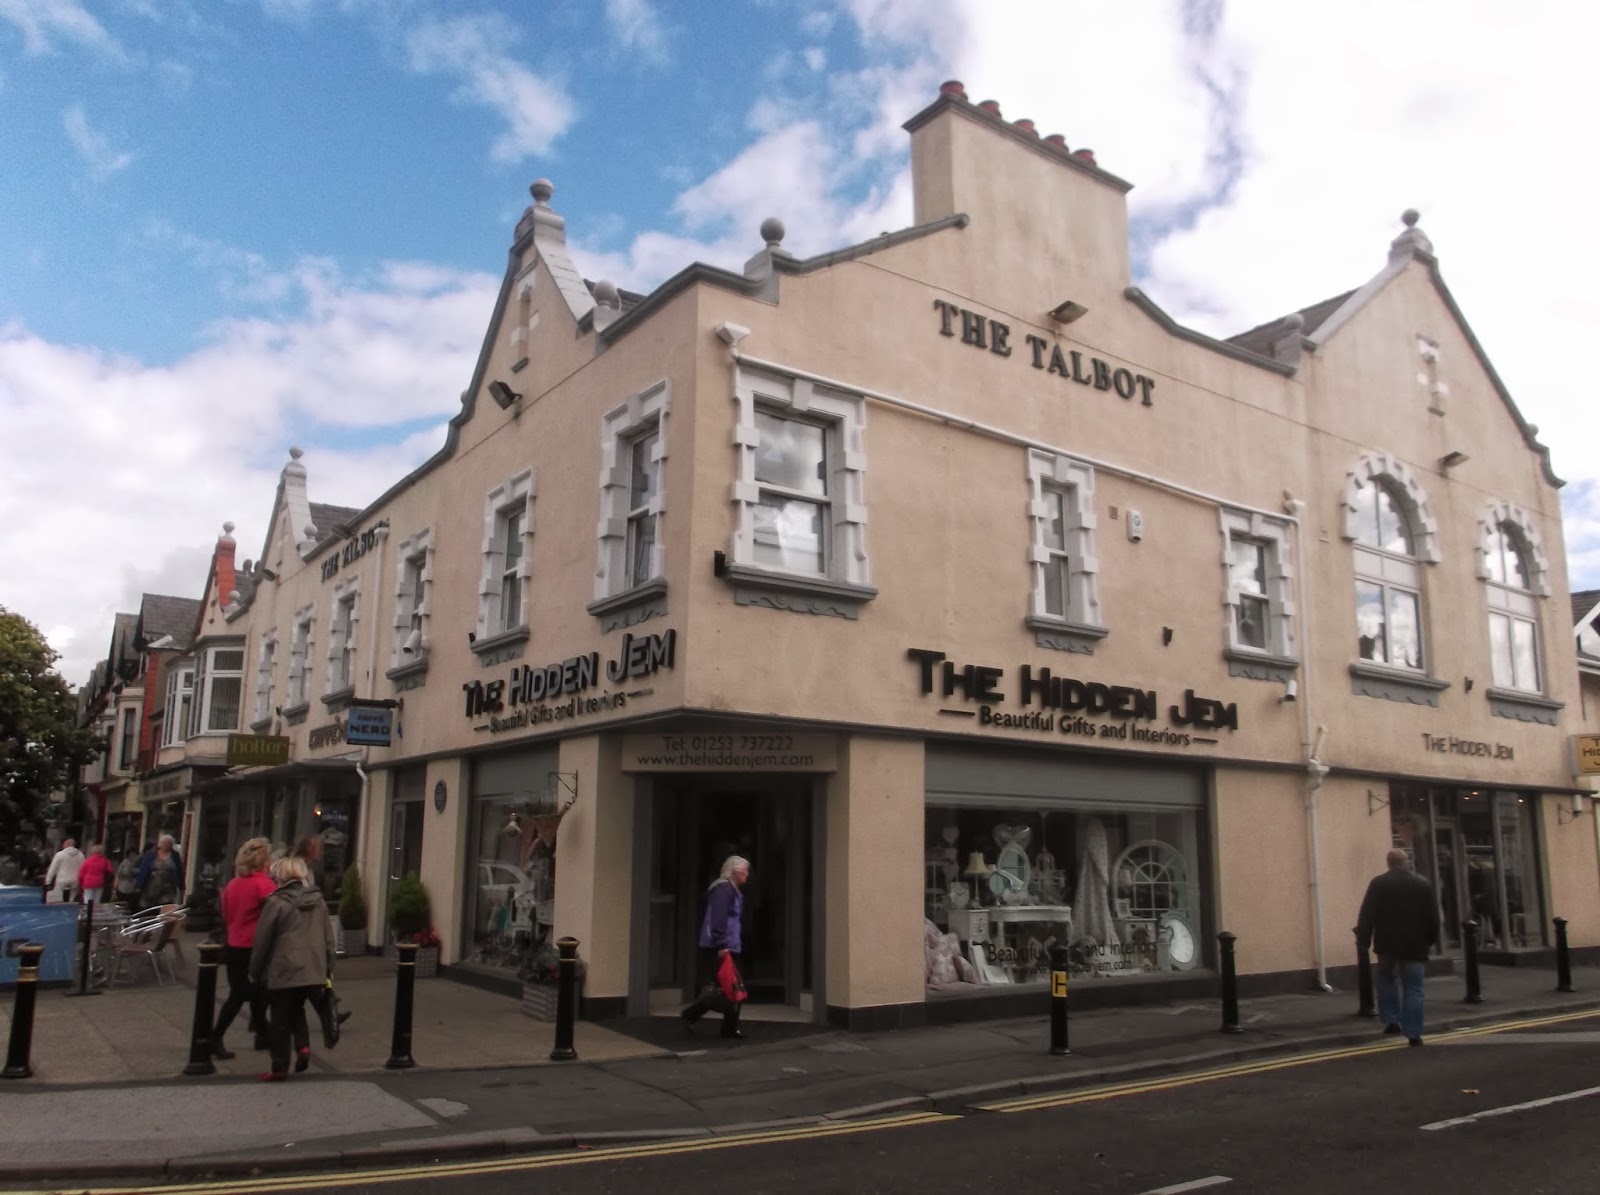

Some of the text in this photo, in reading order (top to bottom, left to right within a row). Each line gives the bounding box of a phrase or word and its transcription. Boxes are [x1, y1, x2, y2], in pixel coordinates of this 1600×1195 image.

[934, 298, 1155, 406] THE TALBOT
[462, 628, 676, 718] THE HIDDEN JEM
[907, 647, 1238, 731] THE HIDDEN JEM
[350, 724, 390, 735] NERO
[979, 705, 1191, 747] Beautiful Gifts and Interiors
[692, 735, 733, 751] 01253
[740, 735, 793, 751] 737222
[1421, 732, 1447, 753] THE
[1449, 736, 1492, 757] HIDDEN
[637, 752, 814, 769] www.thehiddenjem.com
